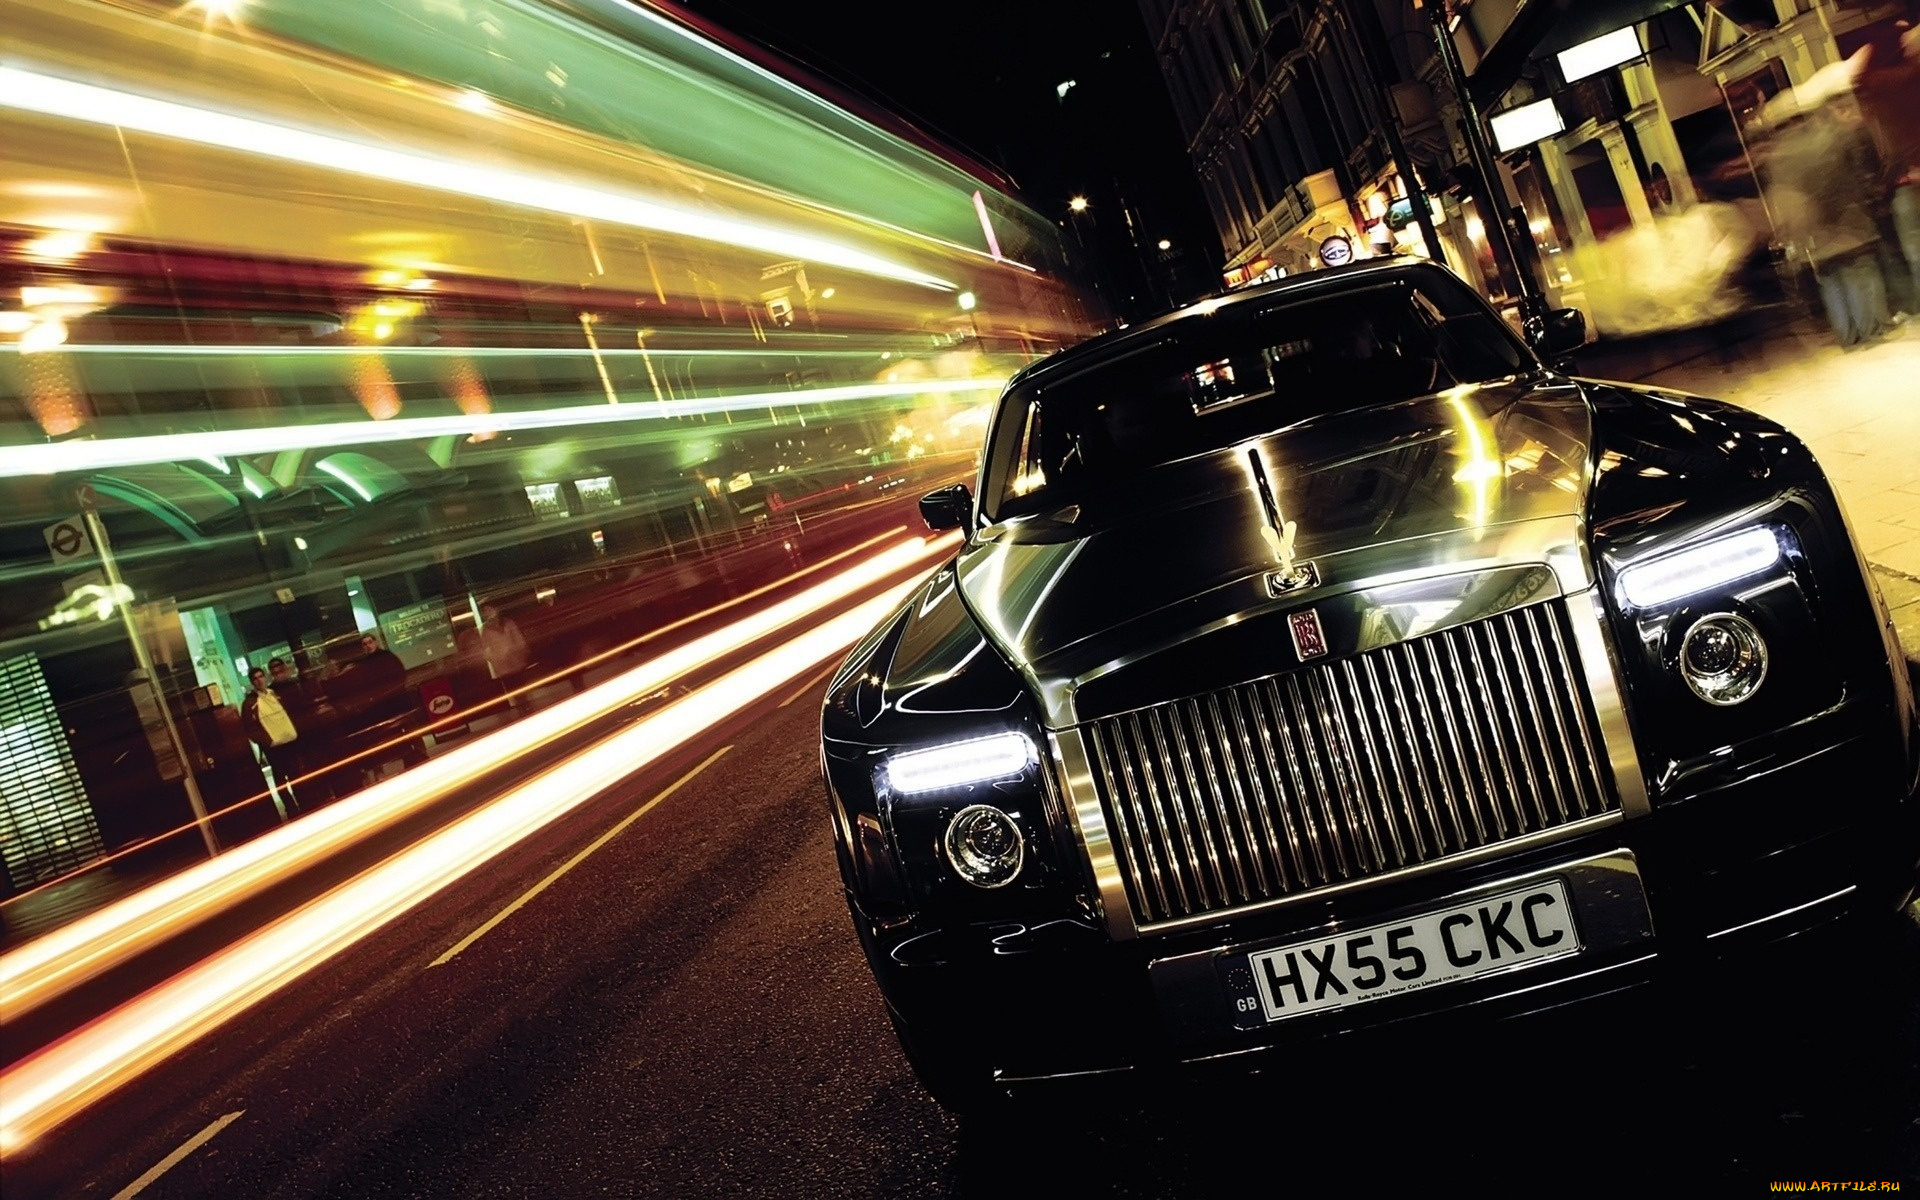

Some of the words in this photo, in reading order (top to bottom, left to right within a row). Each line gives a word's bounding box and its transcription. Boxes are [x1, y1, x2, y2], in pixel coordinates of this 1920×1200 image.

[1262, 925, 1426, 1008] HX55
[1440, 892, 1564, 968] CKC
[1390, 986, 1406, 994] Motor
[1421, 977, 1442, 986] Limited
[1236, 996, 1258, 1012] GB
